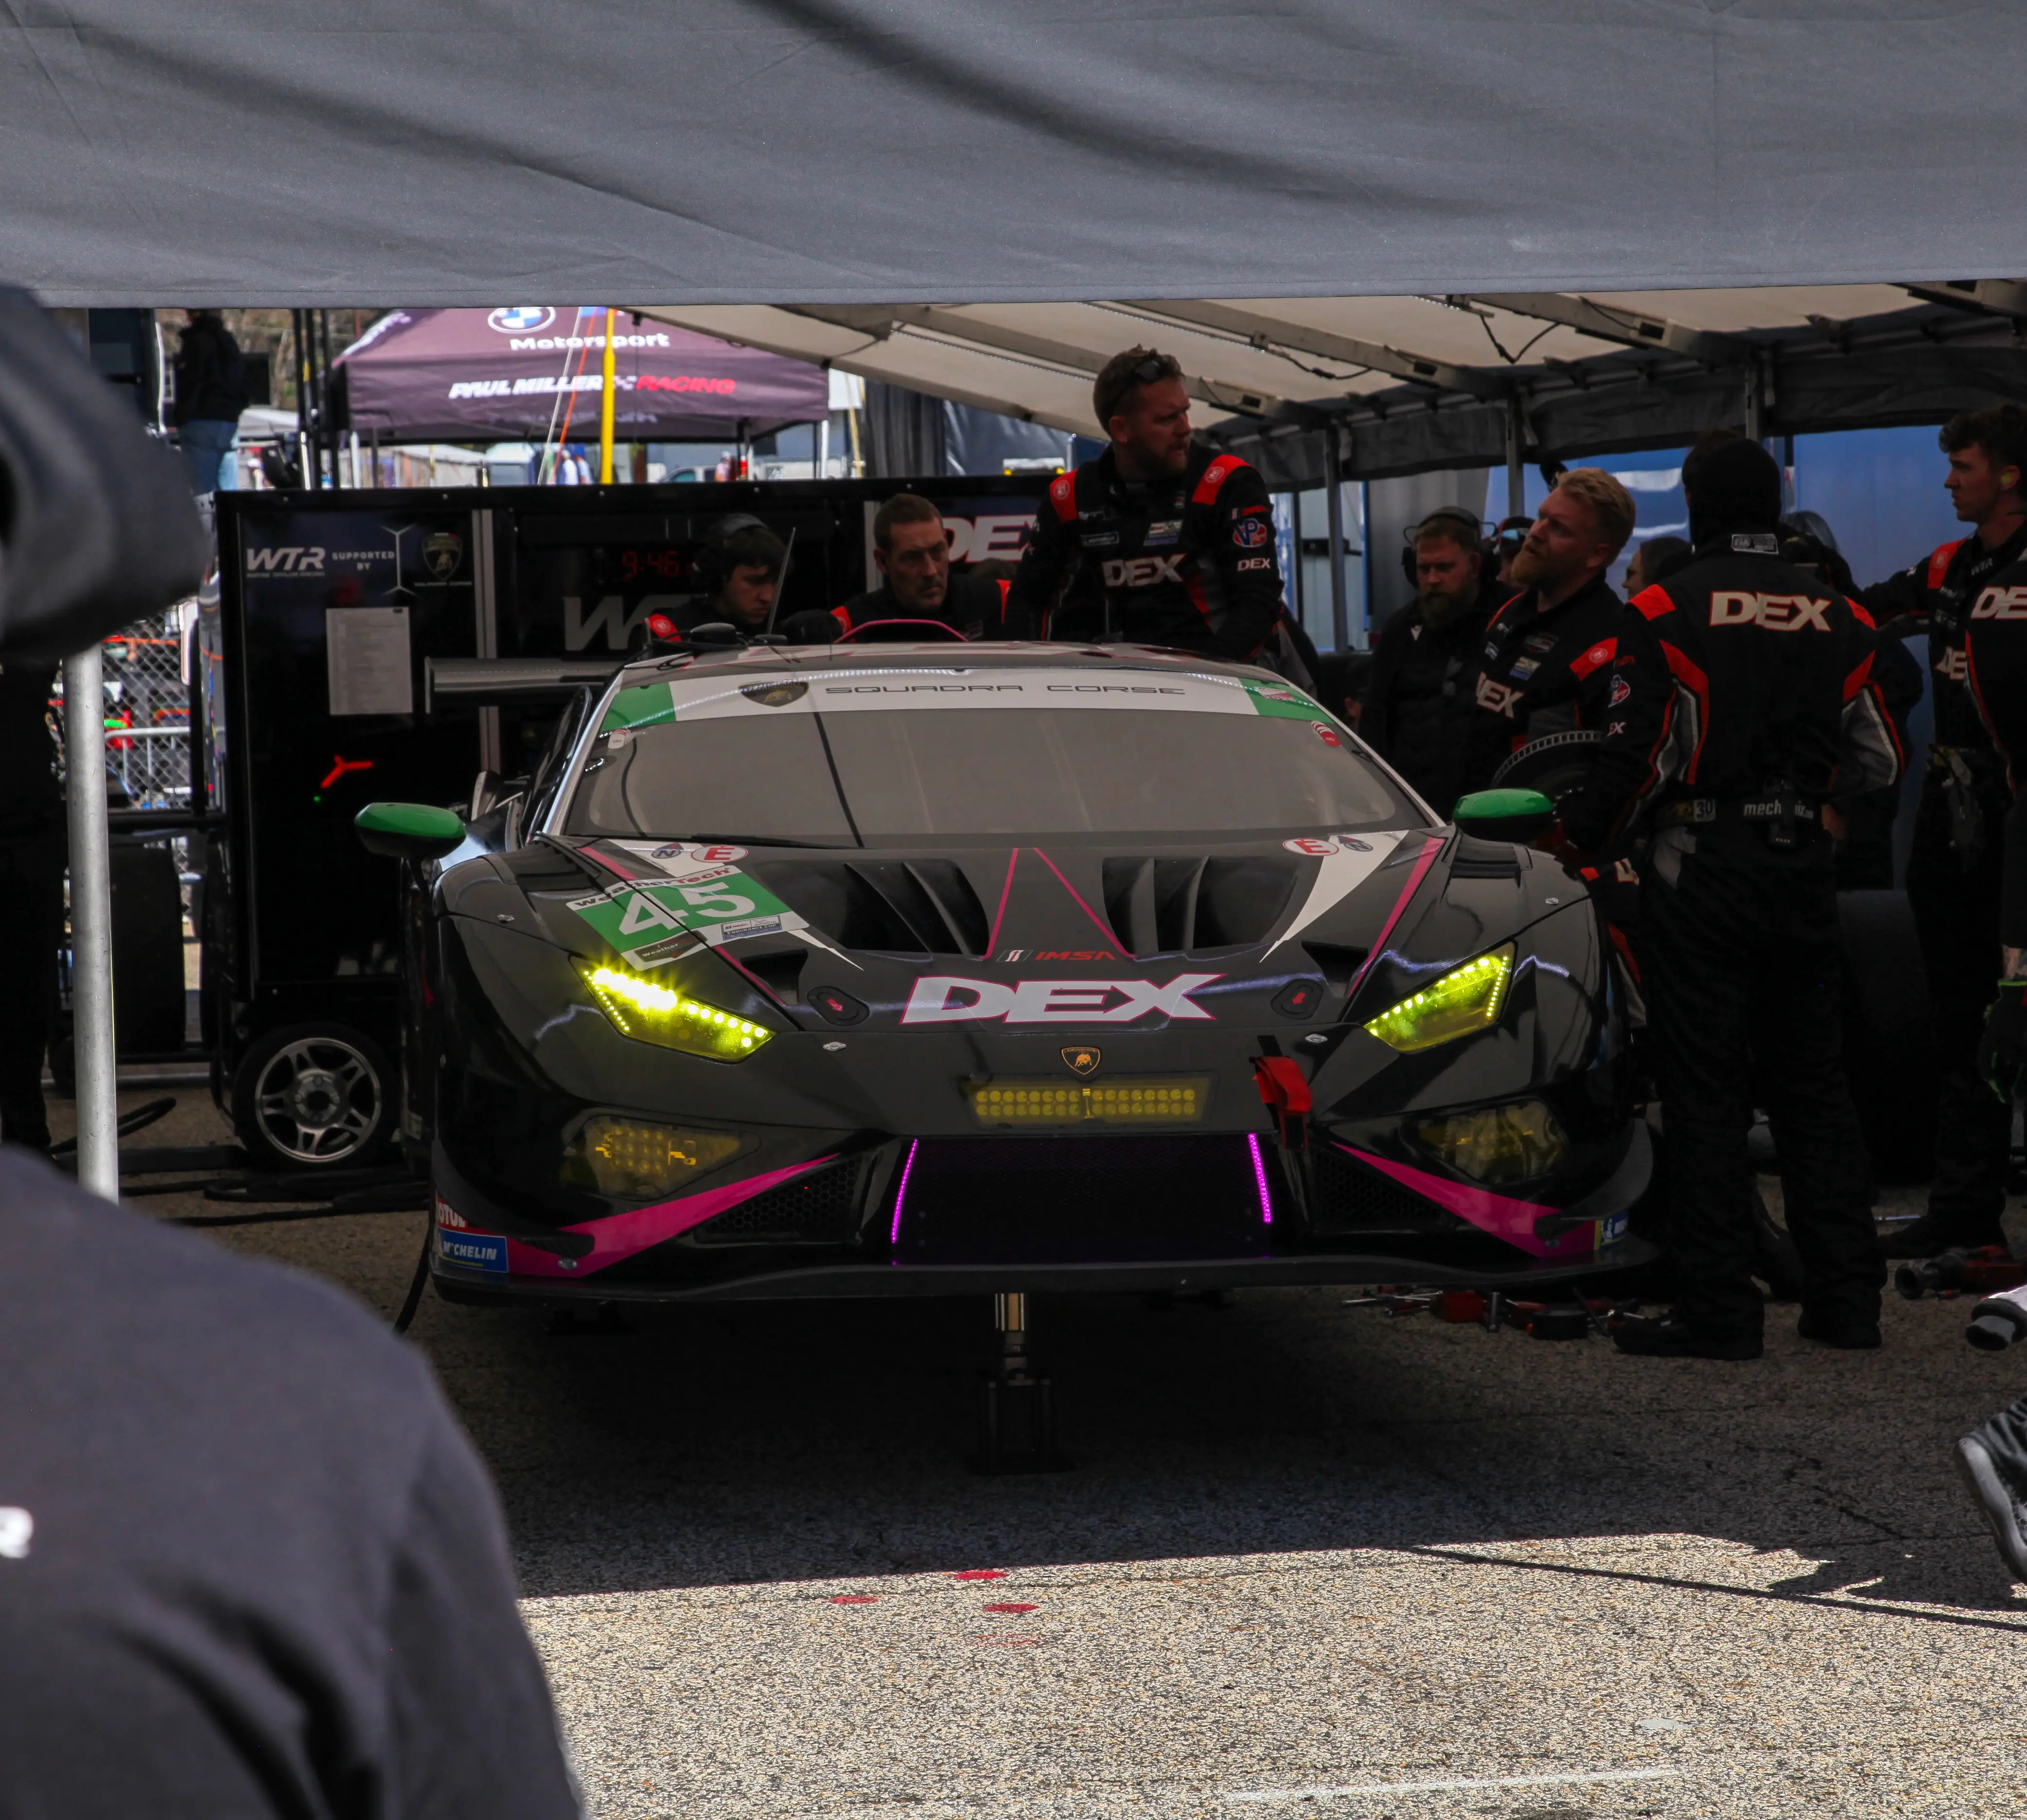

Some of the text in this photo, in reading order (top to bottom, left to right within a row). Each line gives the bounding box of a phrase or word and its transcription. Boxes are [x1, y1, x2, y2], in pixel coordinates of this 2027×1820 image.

[510, 332, 670, 351] Motorsport
[448, 375, 736, 399] PAUL MILLER RACING
[246, 546, 326, 571] WTR
[332, 551, 395, 561] SUPPORTED
[356, 562, 371, 571] BY
[1236, 557, 1271, 573] DEX
[1100, 552, 1188, 587] DEX
[1708, 590, 1833, 632] DEX
[826, 685, 1186, 695] SQUADRA CORSE
[618, 882, 756, 935] 45
[1034, 951, 1117, 961] IMSA
[899, 974, 1228, 1024] DEX
[437, 1202, 466, 1228] OTUL
